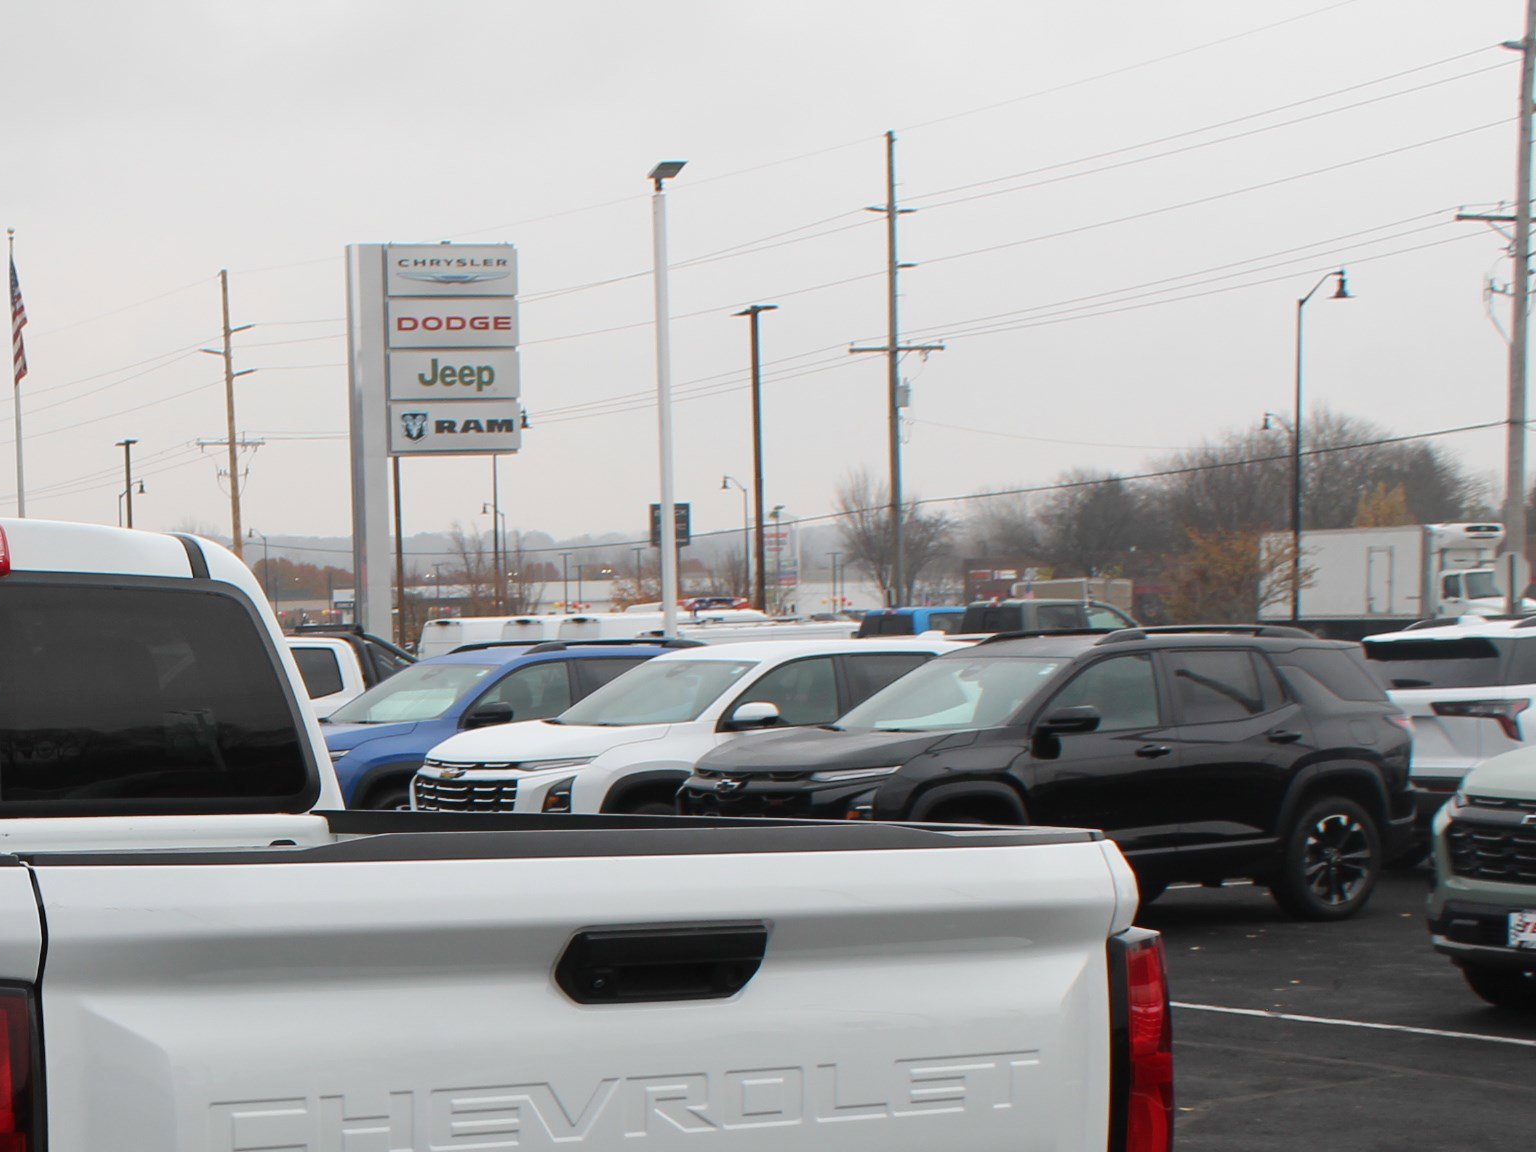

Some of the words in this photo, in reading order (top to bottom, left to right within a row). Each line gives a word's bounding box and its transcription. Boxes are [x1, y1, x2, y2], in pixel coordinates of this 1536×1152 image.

[397, 258, 508, 268] CHRYSLER
[396, 316, 512, 331] DODGE
[418, 358, 495, 392] Jeep
[434, 419, 514, 434] RAM
